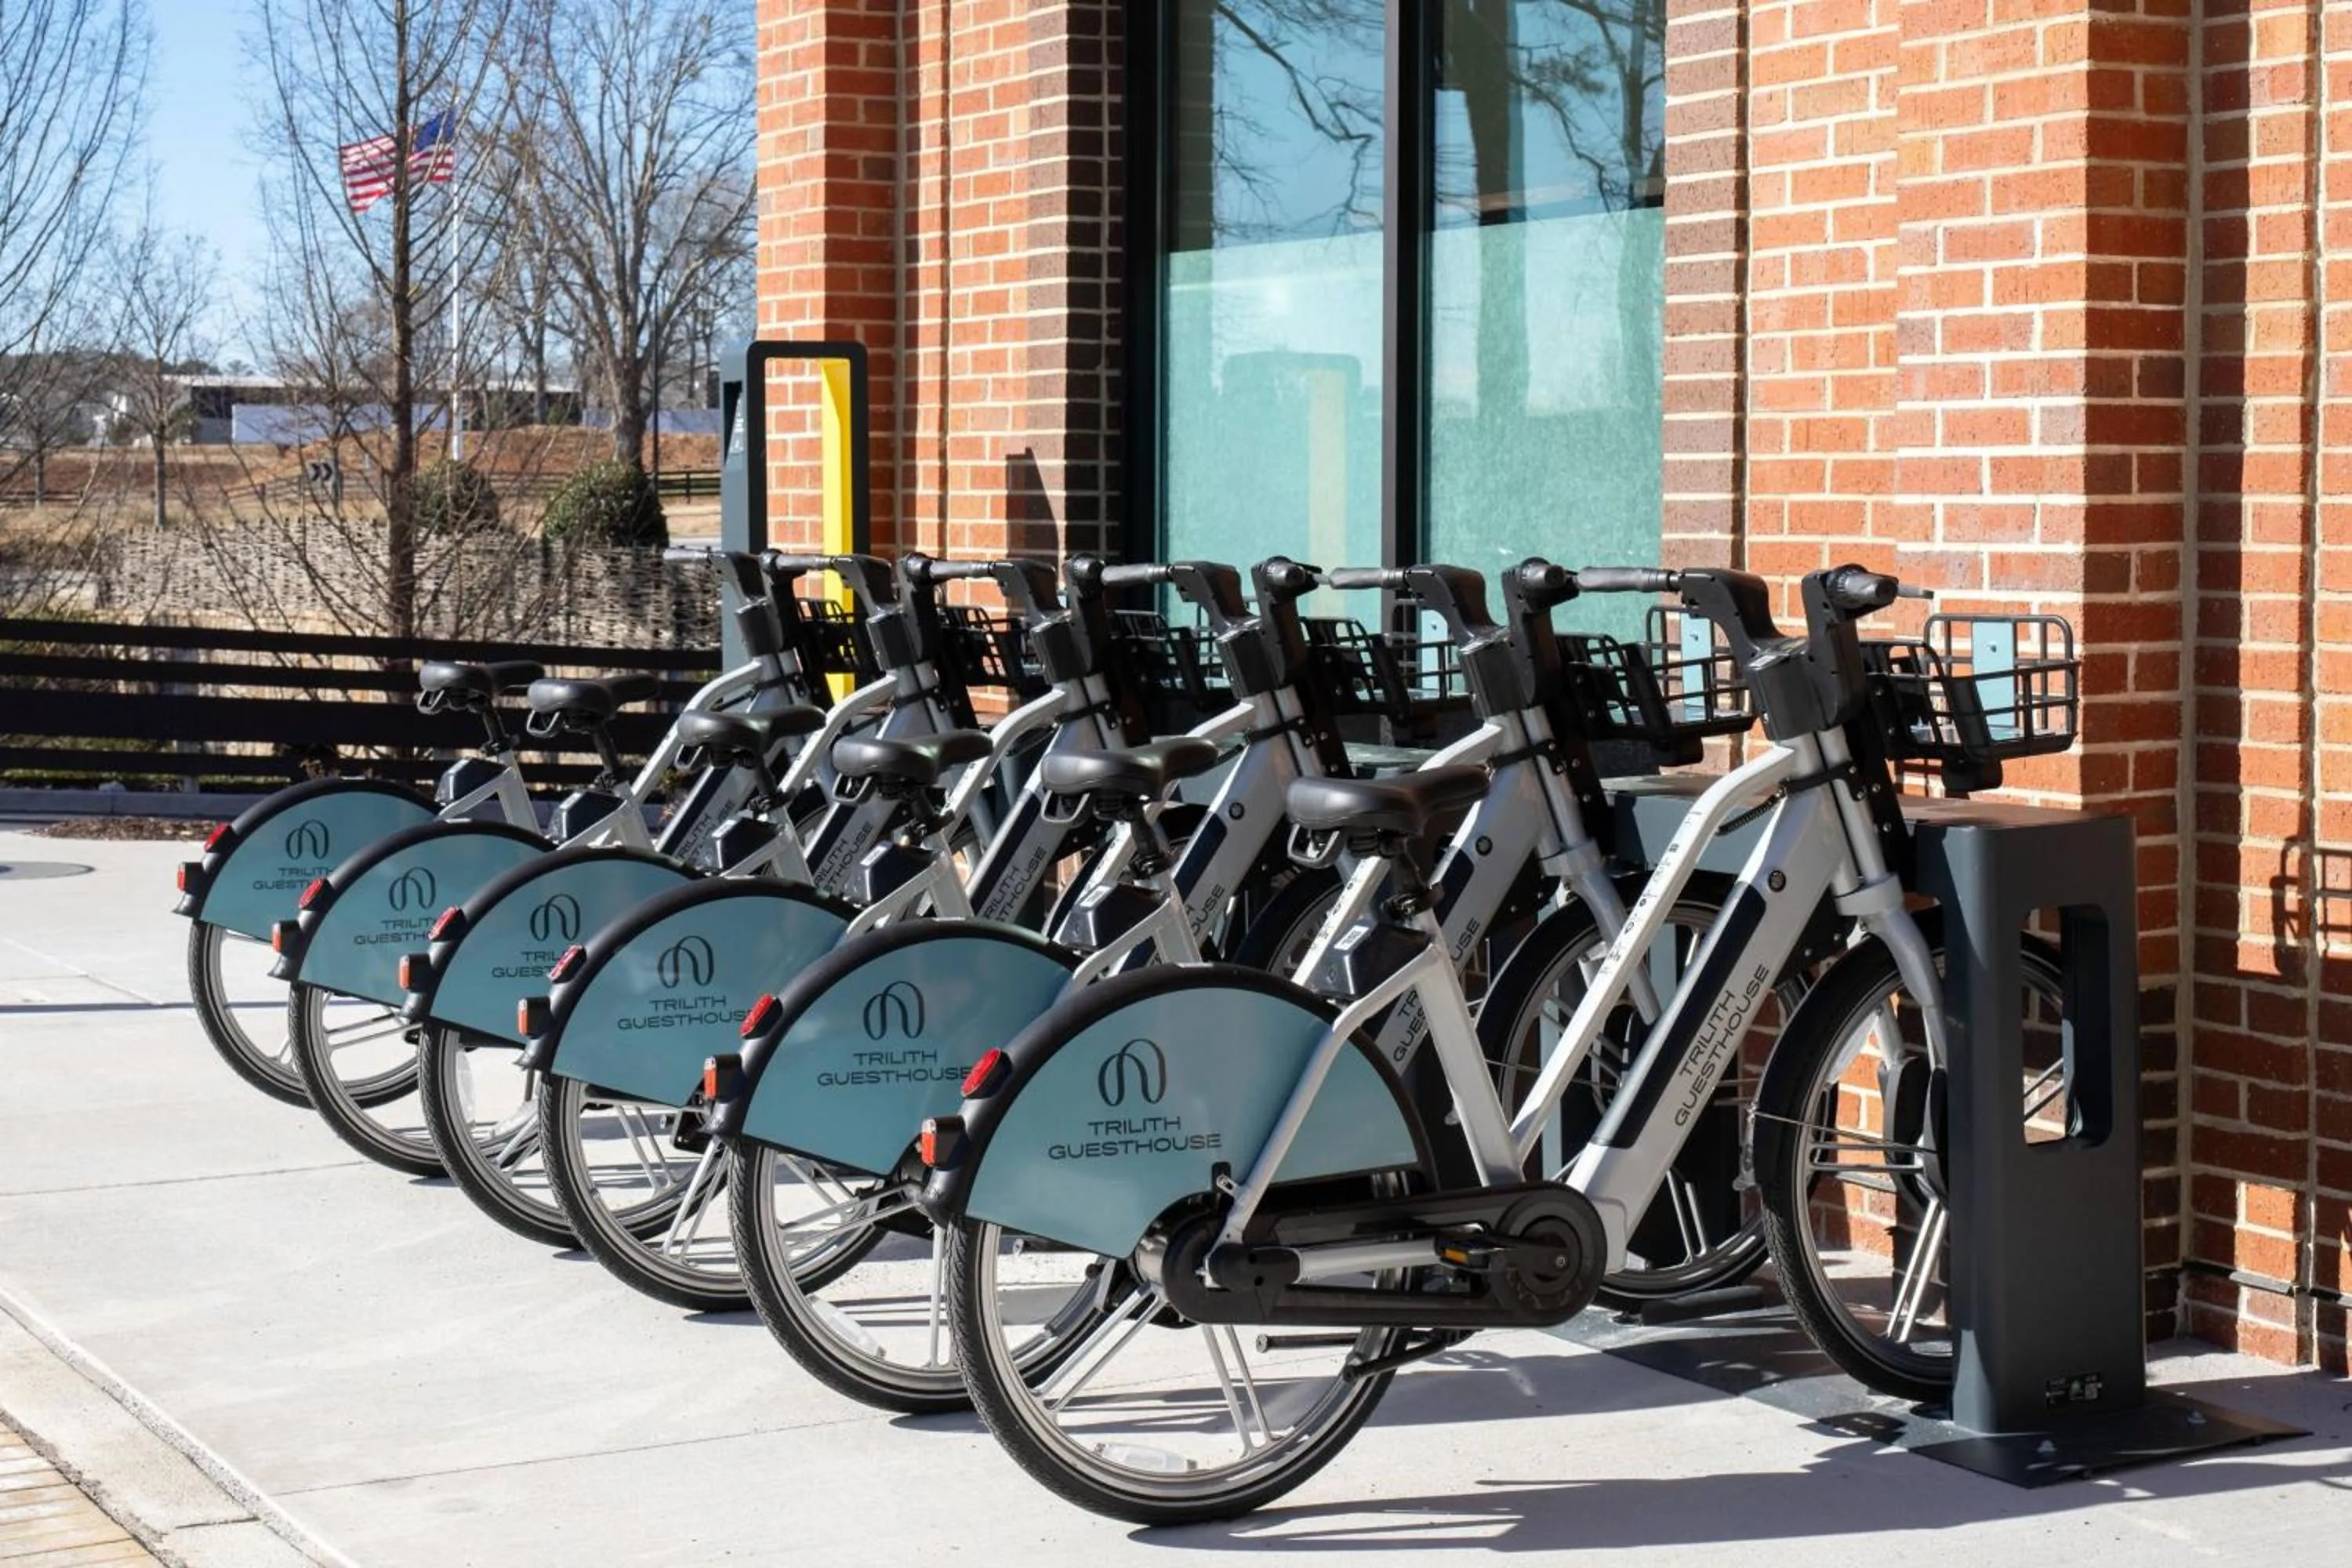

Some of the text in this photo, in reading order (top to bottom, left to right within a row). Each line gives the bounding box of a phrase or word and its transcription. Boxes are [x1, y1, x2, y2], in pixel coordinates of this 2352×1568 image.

[252, 879, 310, 890] GUEST
[983, 865, 1019, 920] RILITH
[380, 916, 436, 930] TRILIT
[354, 931, 428, 945] GUESTH
[521, 949, 560, 962] TRIL
[649, 995, 727, 1012] TRILITH
[617, 1009, 752, 1030] GUESTHOUS
[1679, 989, 1736, 1077] TRILITH
[1674, 964, 1769, 1127] GUESTHOUSE
[852, 1049, 938, 1066] TRILITH
[817, 1065, 974, 1087] GUESTHOUSE
[1087, 1116, 1182, 1136] TRILITH
[1047, 1133, 1223, 1160] GUESTHOUSE
